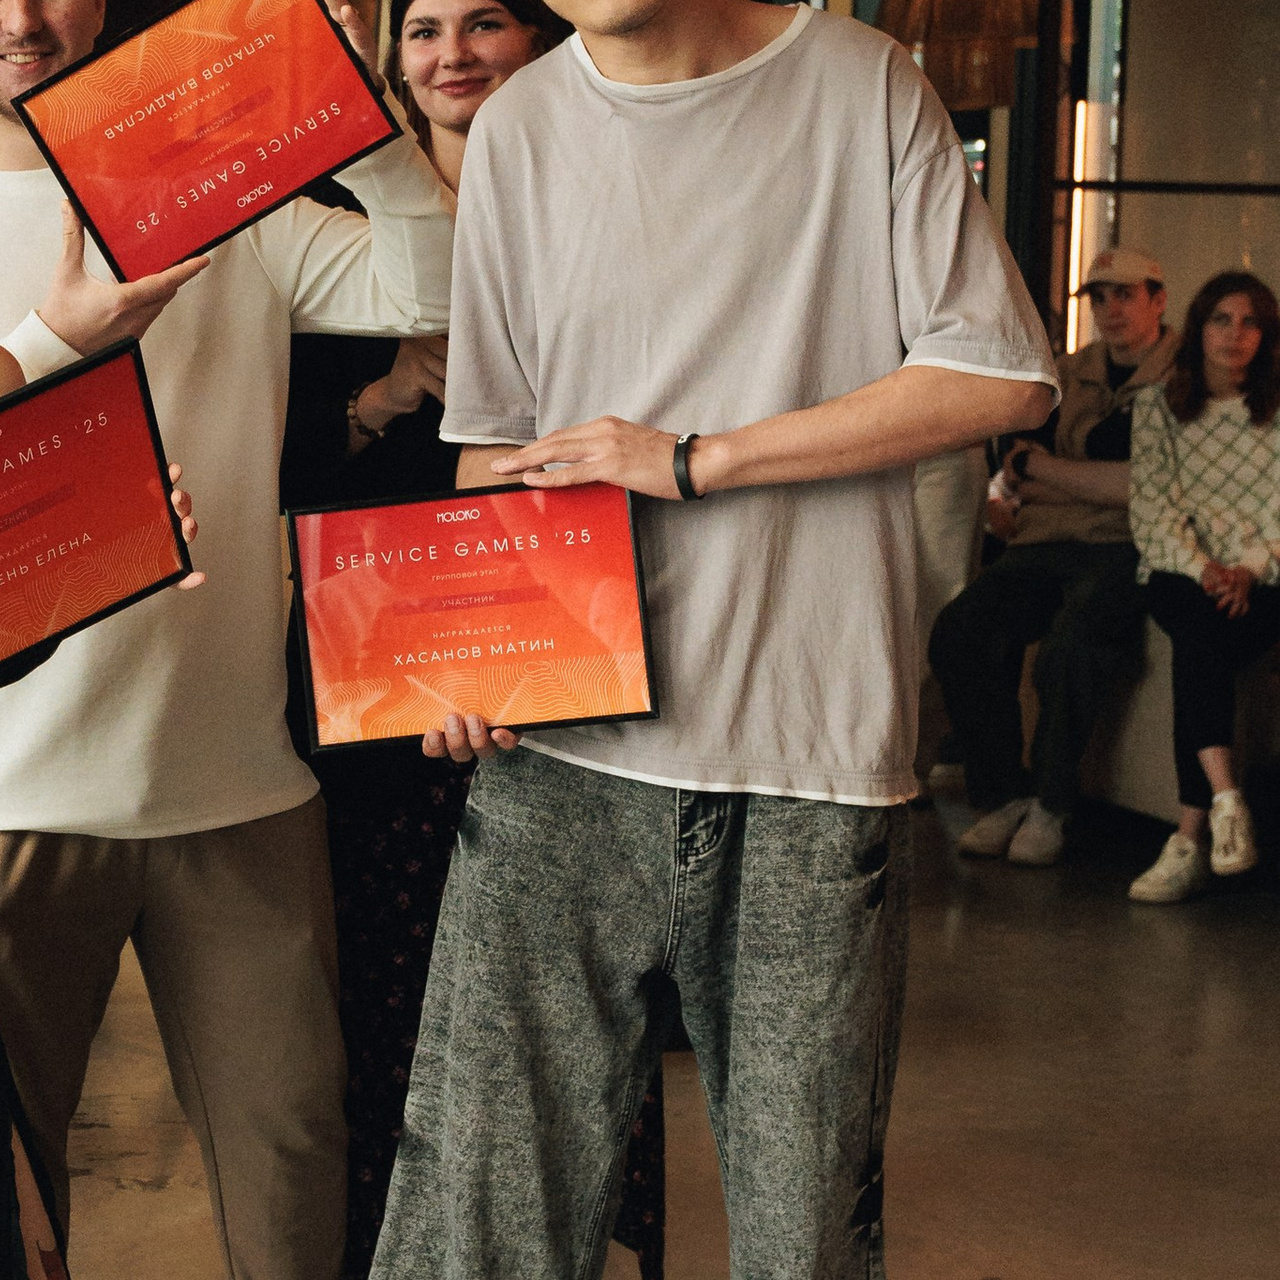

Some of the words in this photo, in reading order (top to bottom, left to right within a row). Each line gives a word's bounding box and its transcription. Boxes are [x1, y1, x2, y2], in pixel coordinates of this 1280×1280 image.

[202, 33, 276, 80] ЧЕПАЛОВ
[104, 77, 198, 140] ВЛАДИСЛАВ
[168, 81, 231, 122] НАГРАЖДАЕТСЯ
[192, 111, 236, 140] УЧАСТНИК
[256, 102, 341, 161] SERVICE
[176, 161, 246, 209] GAMES
[237, 181, 273, 208] MOLOKO
[136, 213, 169, 233] '25
[75, 412, 108, 434] '25
[437, 508, 480, 523] MOLOKO
[36, 532, 92, 567] ЕЛЕНА
[335, 545, 438, 570] SERVICE
[454, 534, 539, 557] GAMES
[555, 529, 591, 546] '25
[479, 568, 499, 578] ЭТАП
[441, 594, 495, 607] УЧАСТНИК
[432, 624, 512, 639] НАГРАЖДАЕТСЯ
[393, 645, 482, 666] ХАСАНОВ
[491, 638, 555, 656] МАТИН
